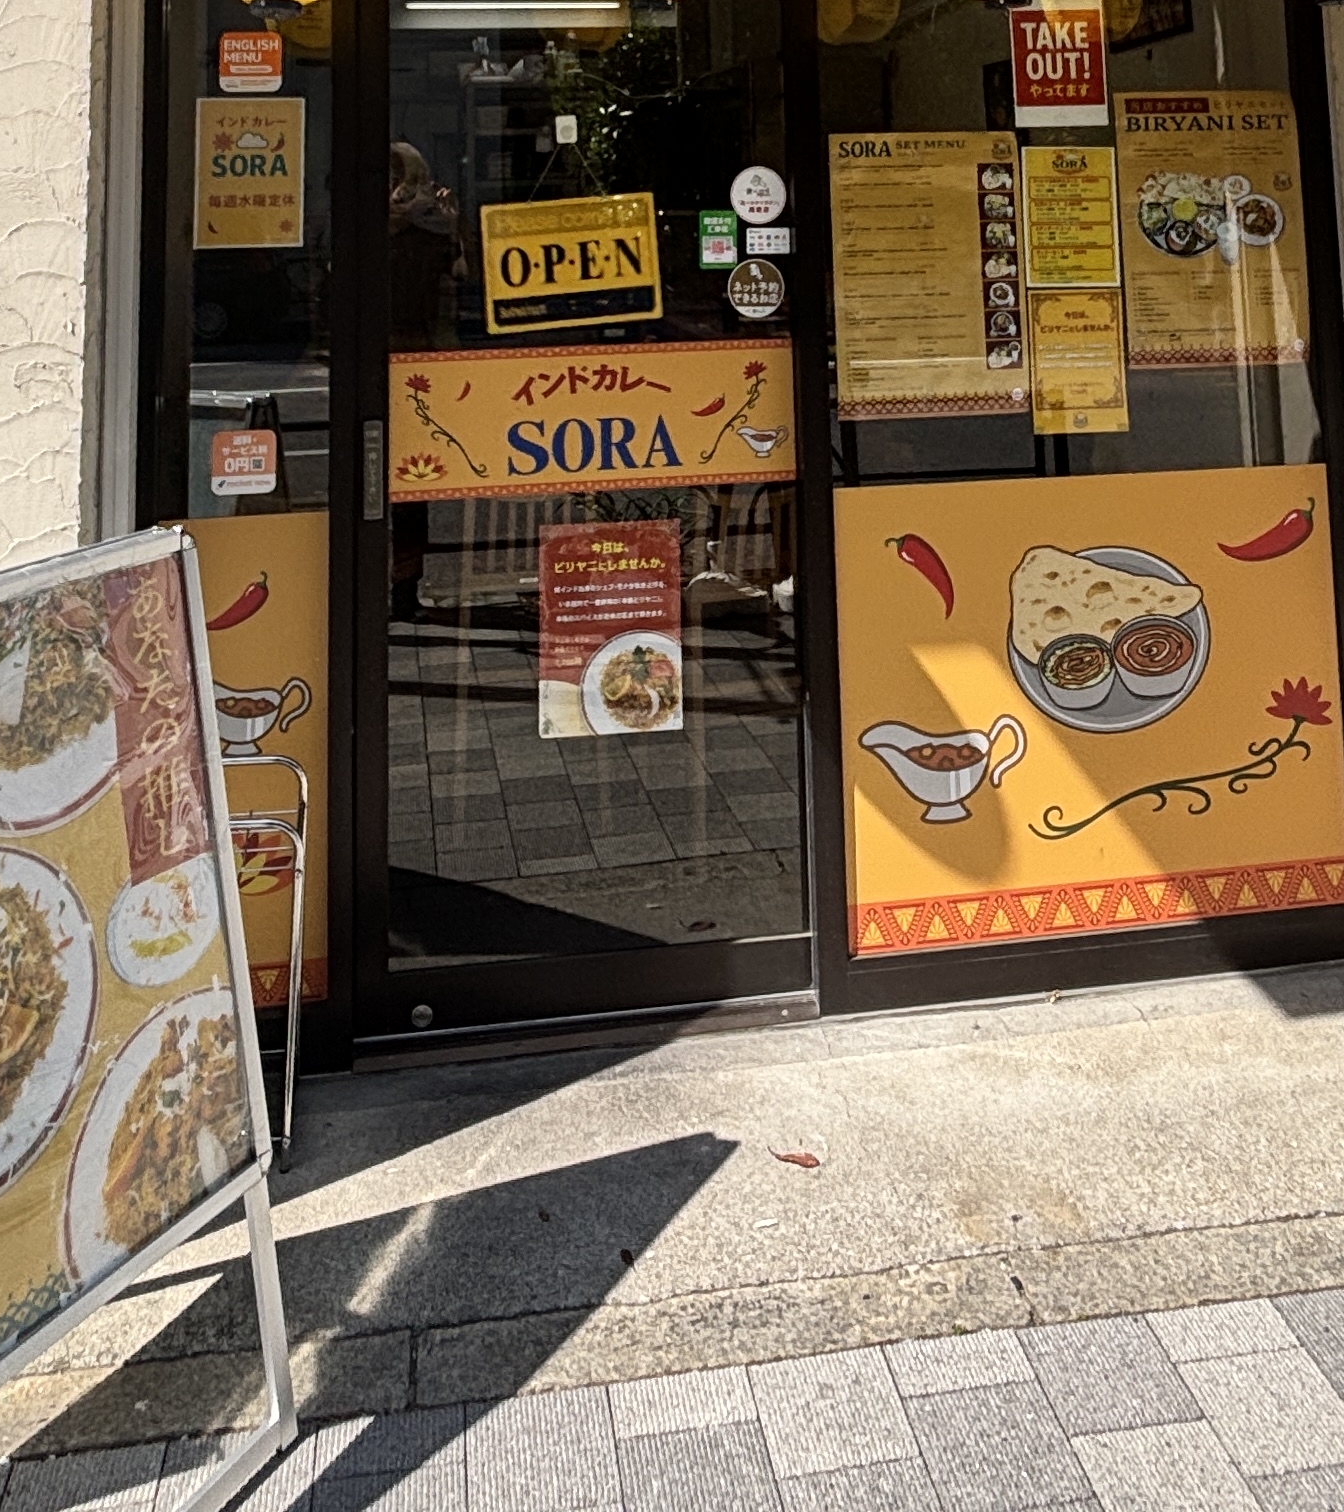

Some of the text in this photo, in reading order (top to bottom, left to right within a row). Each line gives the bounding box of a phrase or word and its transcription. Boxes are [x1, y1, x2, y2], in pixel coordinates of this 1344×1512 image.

[1020, 21, 1090, 50] TAKE
[223, 39, 279, 51] ENGLISH
[223, 51, 263, 63] MENU
[1026, 52, 1091, 80] OUT!
[1030, 83, 1091, 98] やってます
[215, 116, 288, 128] インドカレー
[1125, 114, 1289, 132] BIRYANI SET
[838, 140, 966, 158] SORA SET MENU
[211, 154, 289, 177] SORA
[1052, 157, 1088, 169] SORA
[208, 193, 296, 208] 毎週水曜定休
[732, 281, 780, 292] ネット予約
[732, 293, 780, 304] できるお店
[511, 364, 672, 406] インドカレー
[507, 414, 684, 477] SORA
[554, 558, 667, 574] ビリヤニにしませんか。
[127, 576, 191, 857] あなたの推し
